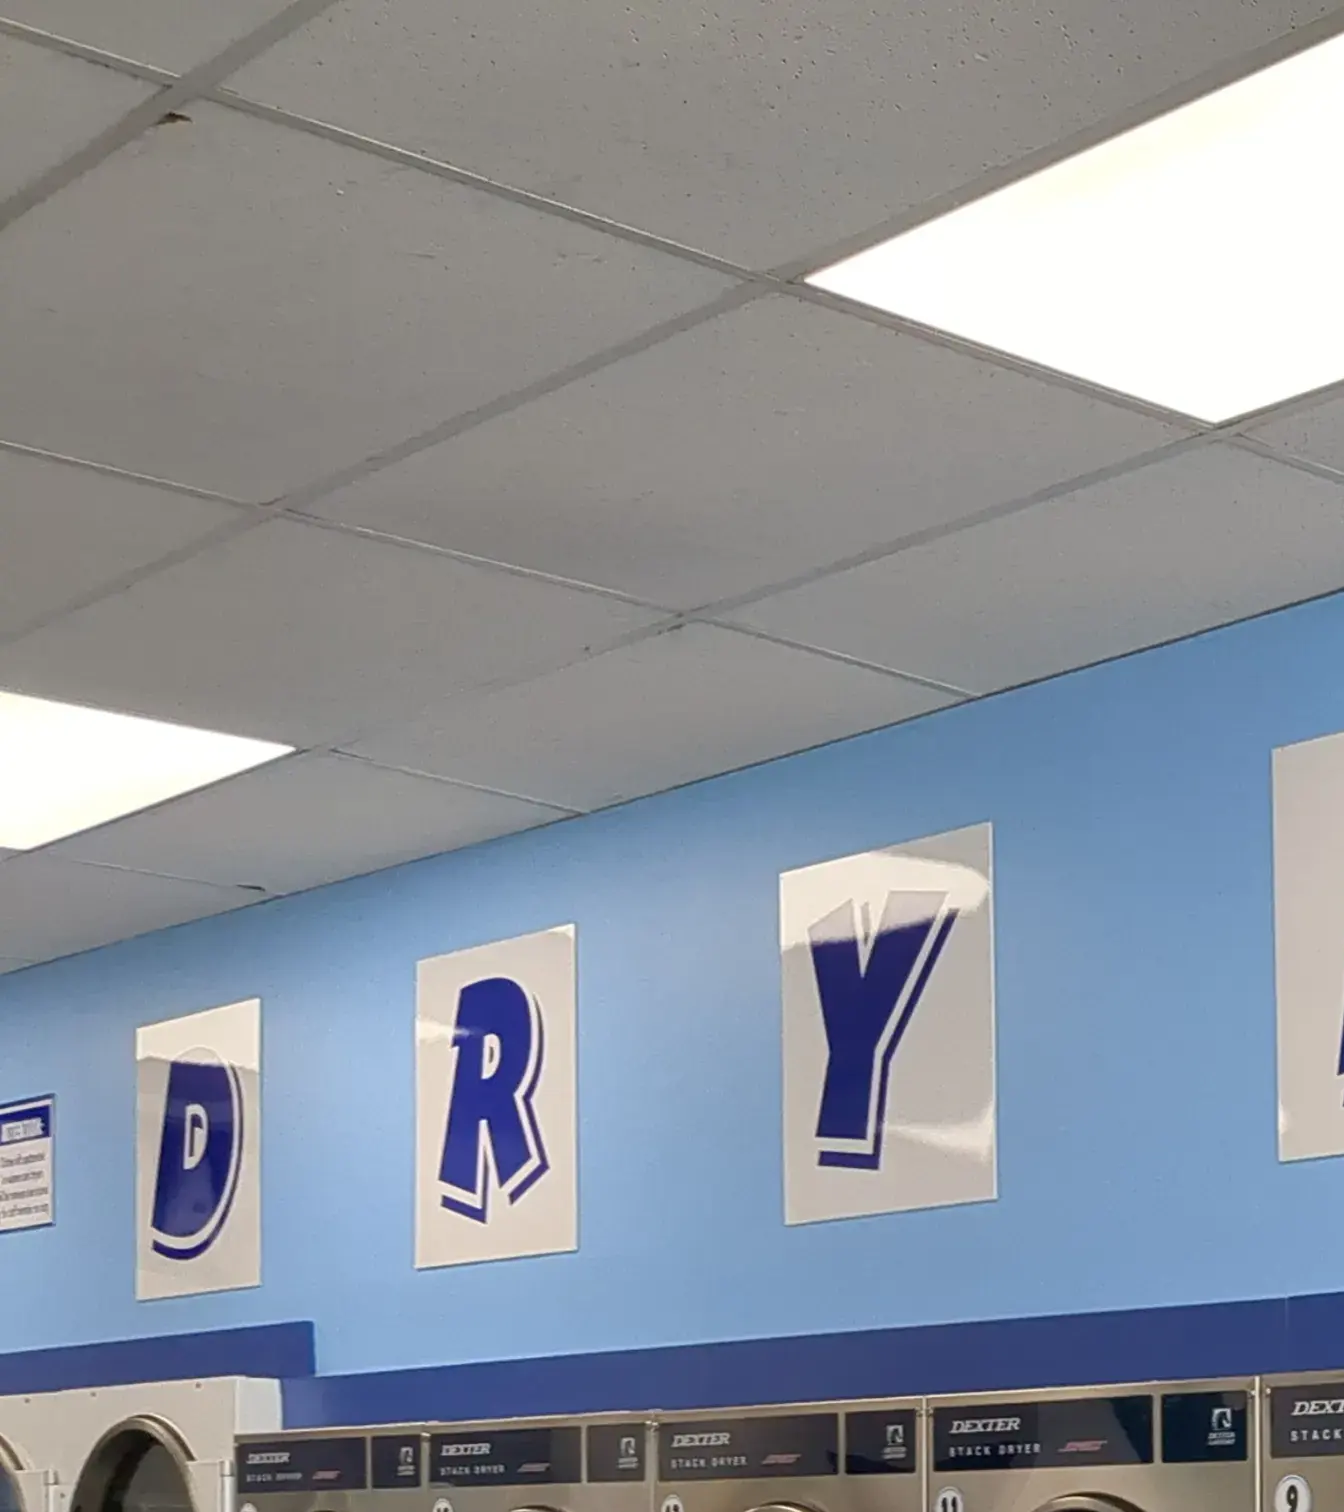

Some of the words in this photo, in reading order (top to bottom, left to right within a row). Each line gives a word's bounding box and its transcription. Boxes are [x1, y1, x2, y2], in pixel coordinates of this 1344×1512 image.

[949, 1417, 1022, 1434] DEXTER
[671, 1433, 731, 1448] DEXTER
[1290, 1427, 1343, 1442] STACK
[949, 1446, 992, 1458] STACK
[999, 1443, 1041, 1455] DRYER
[671, 1458, 706, 1469] STACK
[712, 1456, 747, 1467] DRYER
